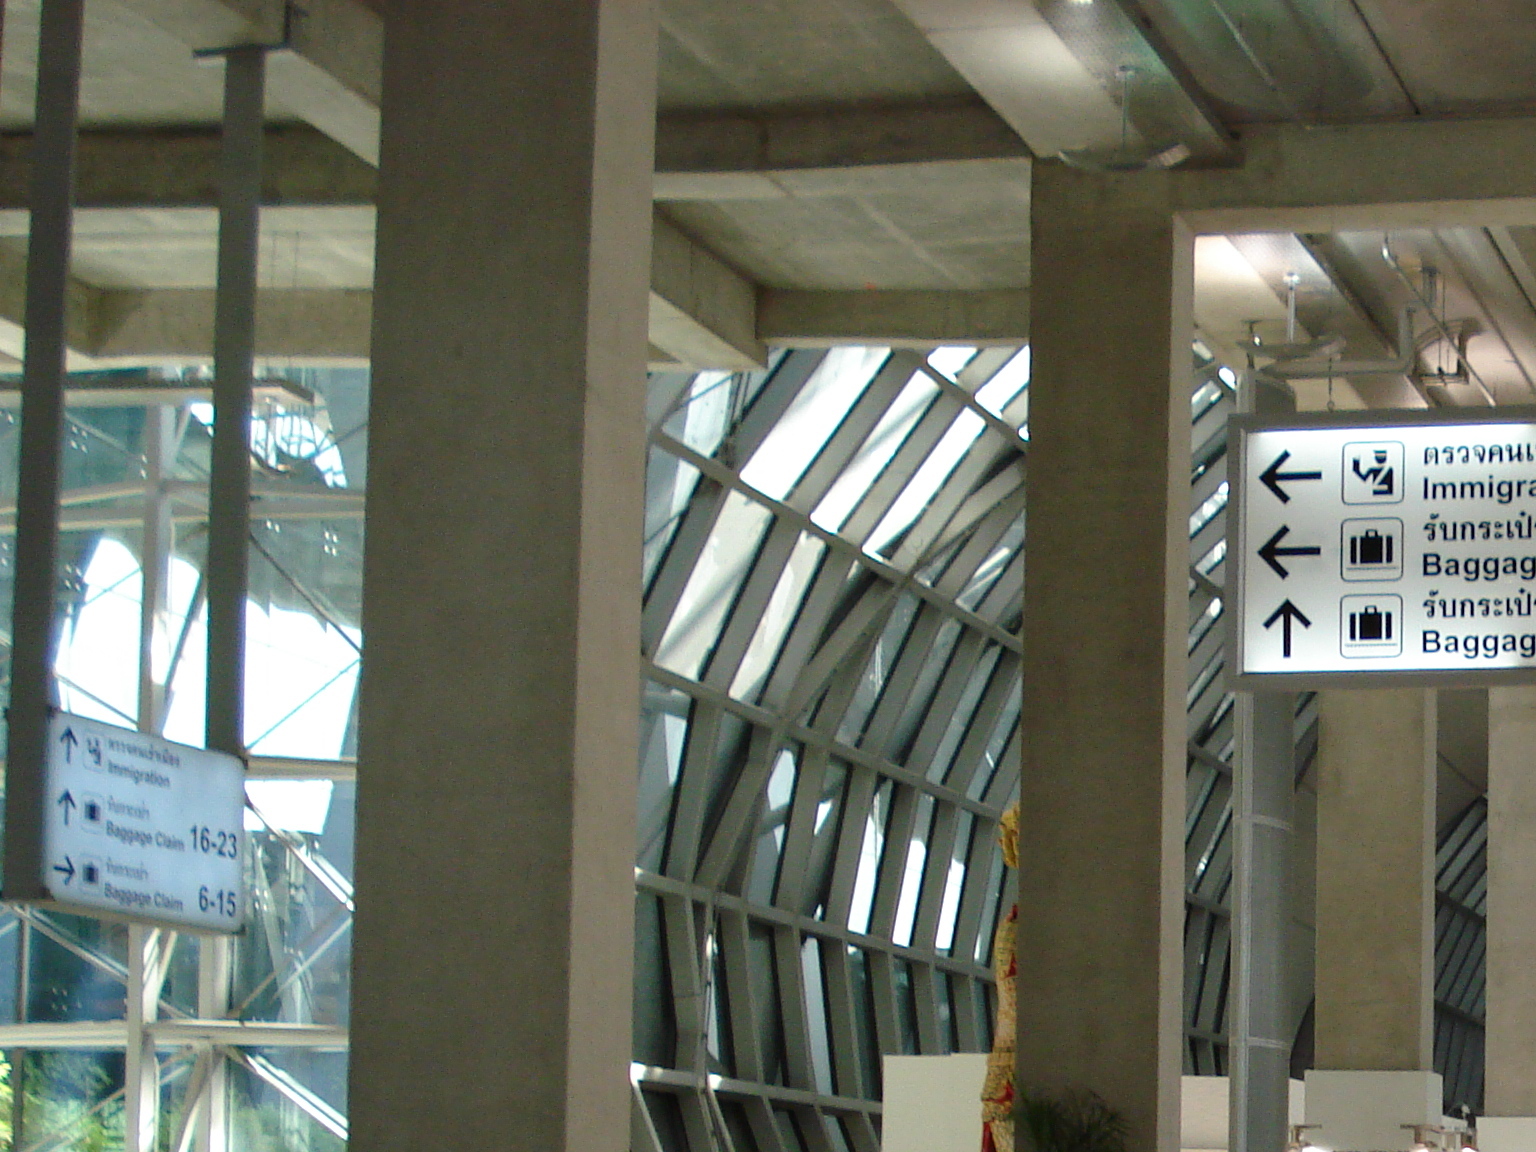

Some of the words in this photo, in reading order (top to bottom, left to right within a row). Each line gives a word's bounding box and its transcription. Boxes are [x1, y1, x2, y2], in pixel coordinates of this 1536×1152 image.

[107, 759, 172, 788] Immigration
[154, 830, 186, 852] Claim
[190, 824, 239, 861] 16-23
[197, 885, 238, 919] 6-15
